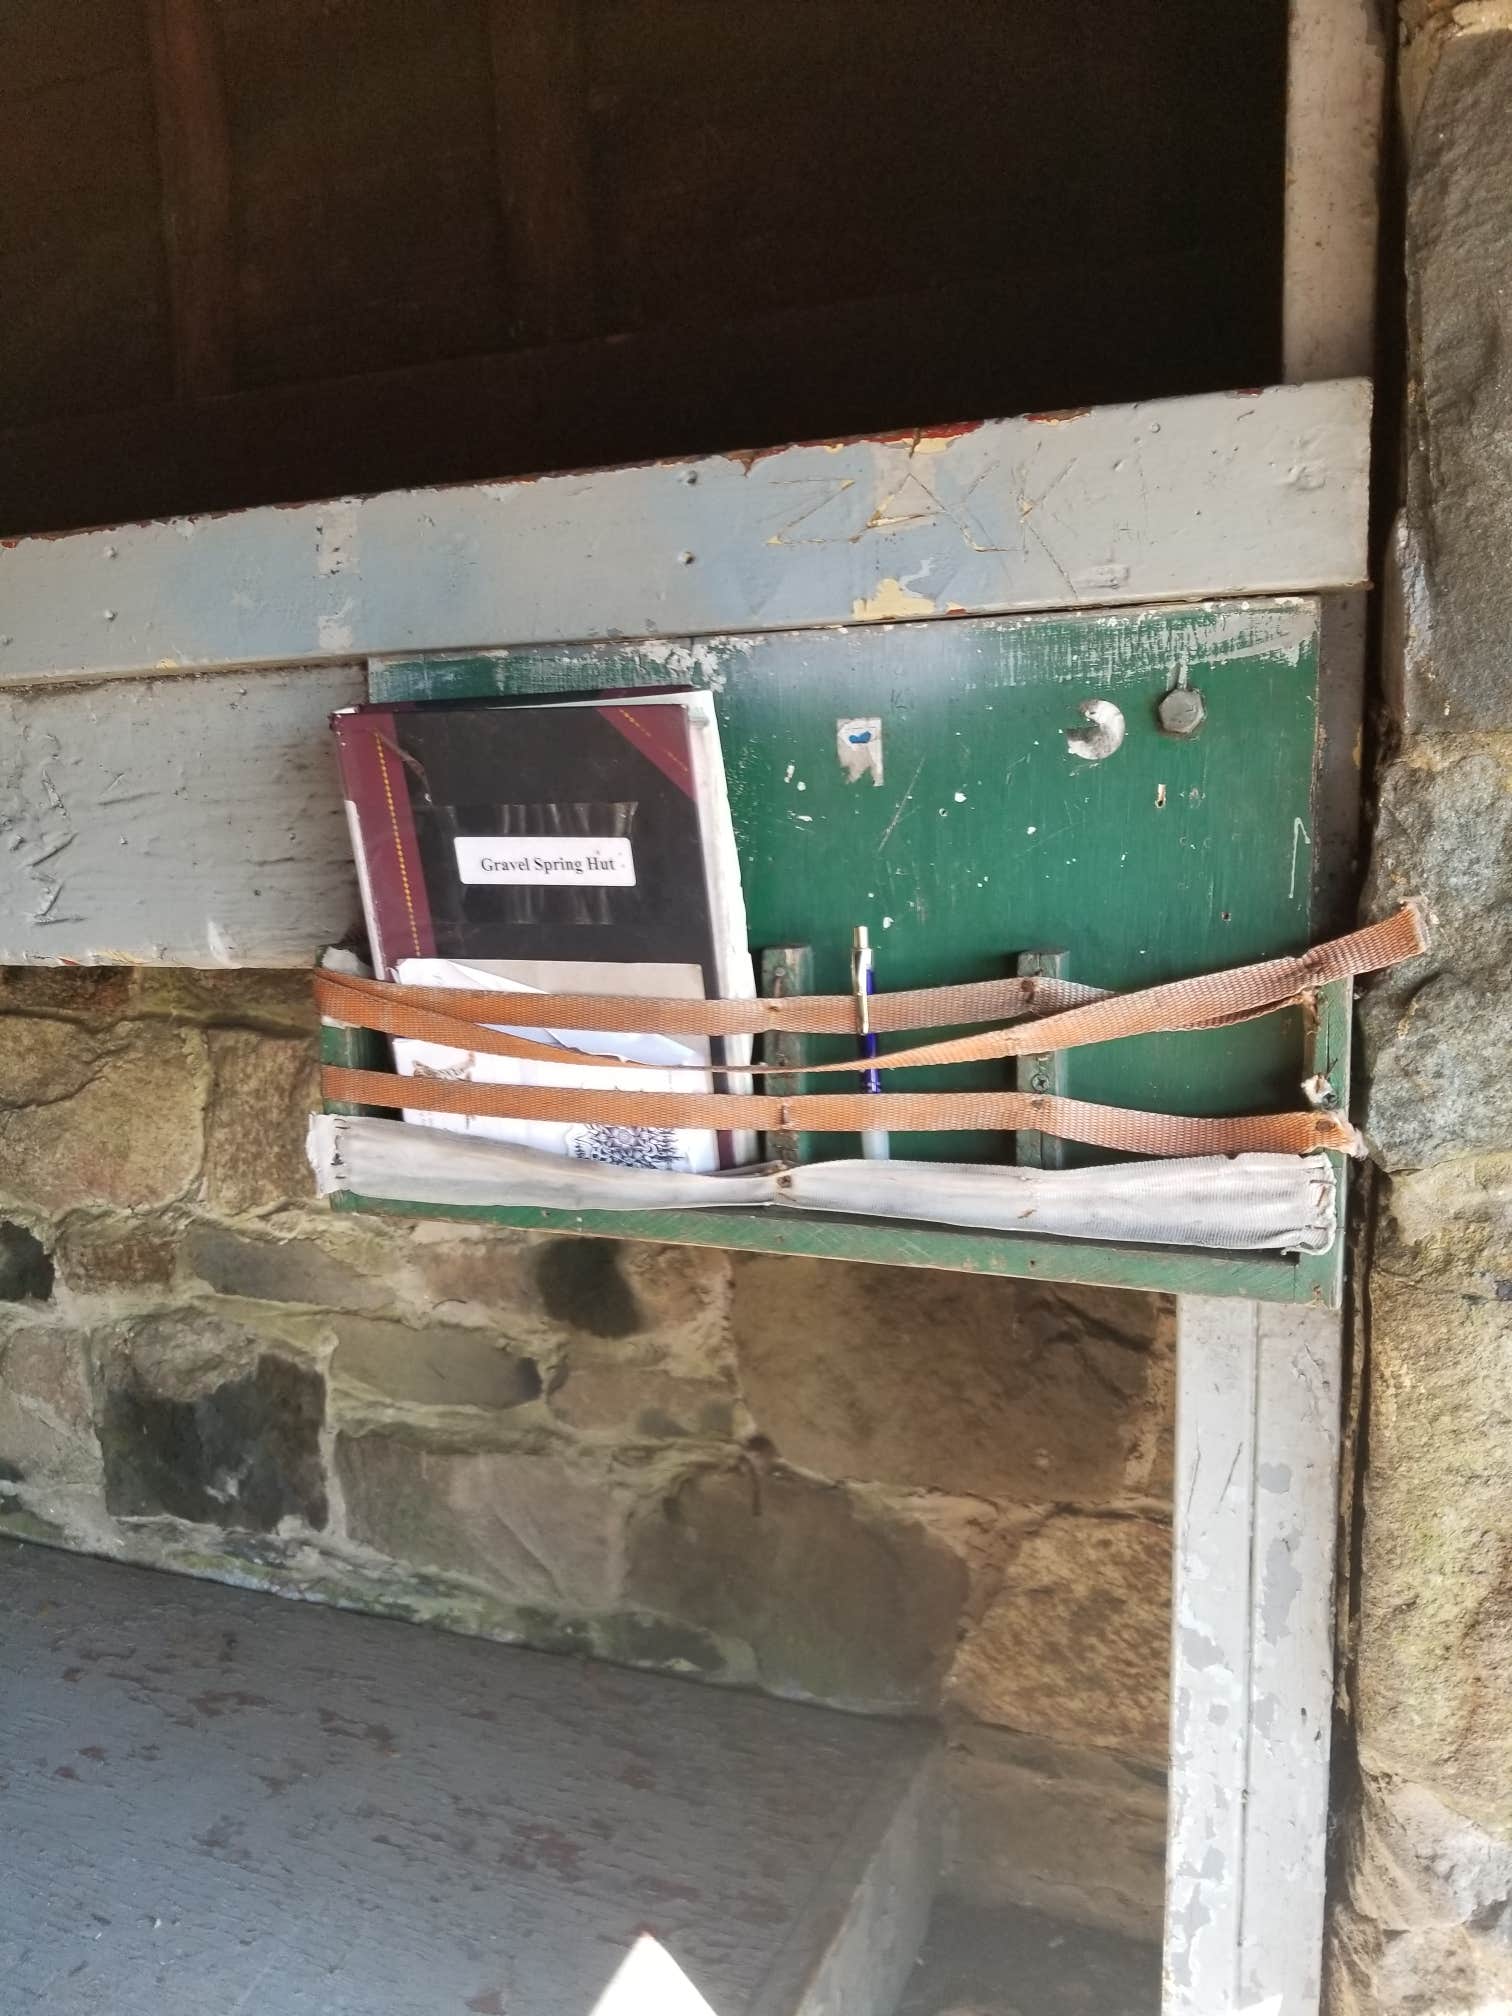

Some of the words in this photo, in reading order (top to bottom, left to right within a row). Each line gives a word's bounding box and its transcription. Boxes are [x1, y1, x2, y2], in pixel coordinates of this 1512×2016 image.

[480, 856, 531, 872] Gravel
[533, 856, 584, 875] Spring
[585, 856, 617, 871] Hut
